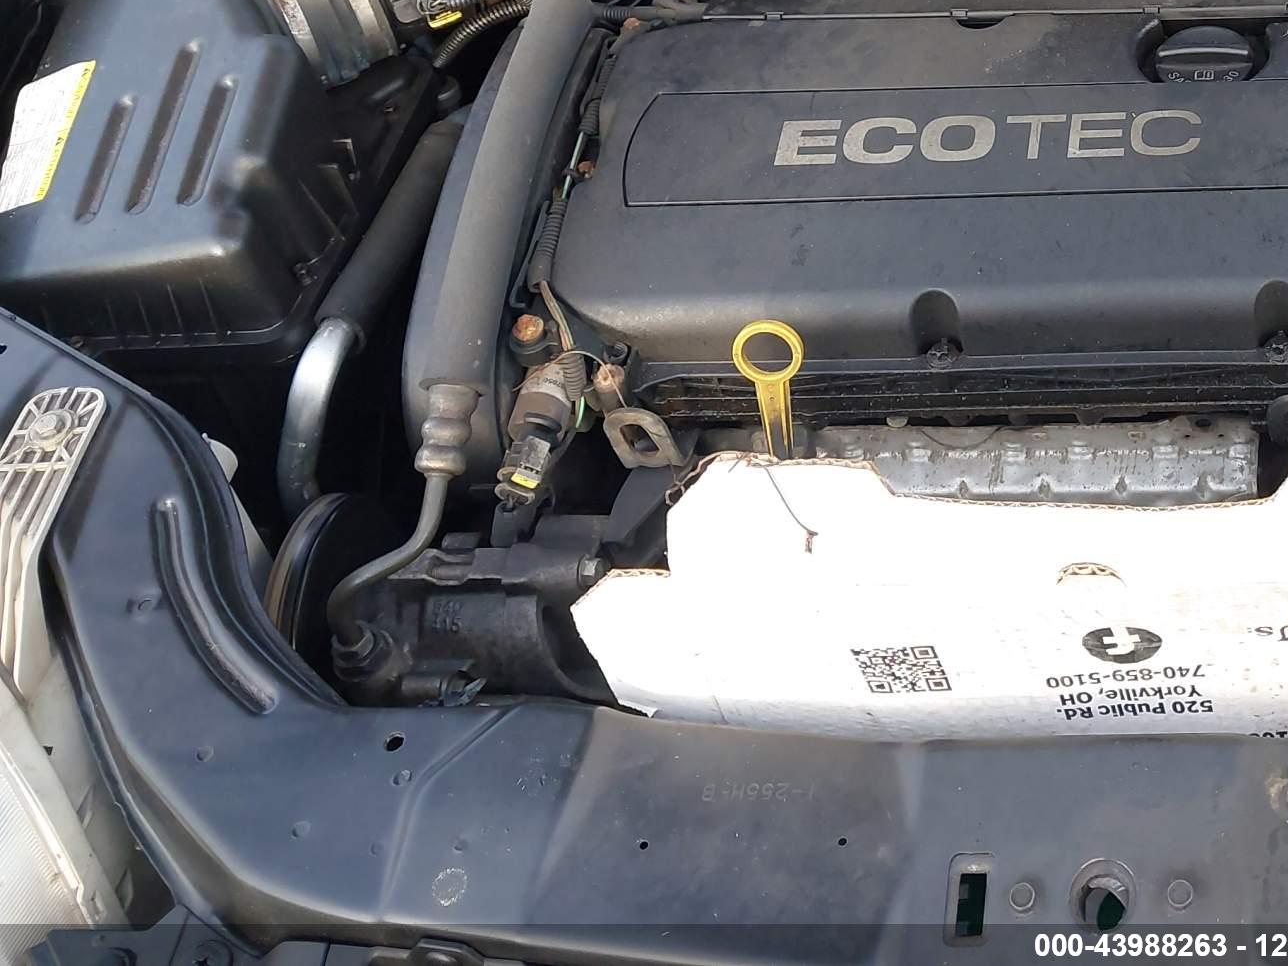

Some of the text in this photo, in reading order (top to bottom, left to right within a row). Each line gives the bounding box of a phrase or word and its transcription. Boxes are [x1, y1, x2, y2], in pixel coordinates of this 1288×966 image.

[773, 110, 1202, 166] ECOTEC
[1046, 664, 1206, 689] 740-859-5100
[1059, 684, 1203, 707] Yorkville, OH
[1056, 699, 1214, 721] 520 Public Rd.
